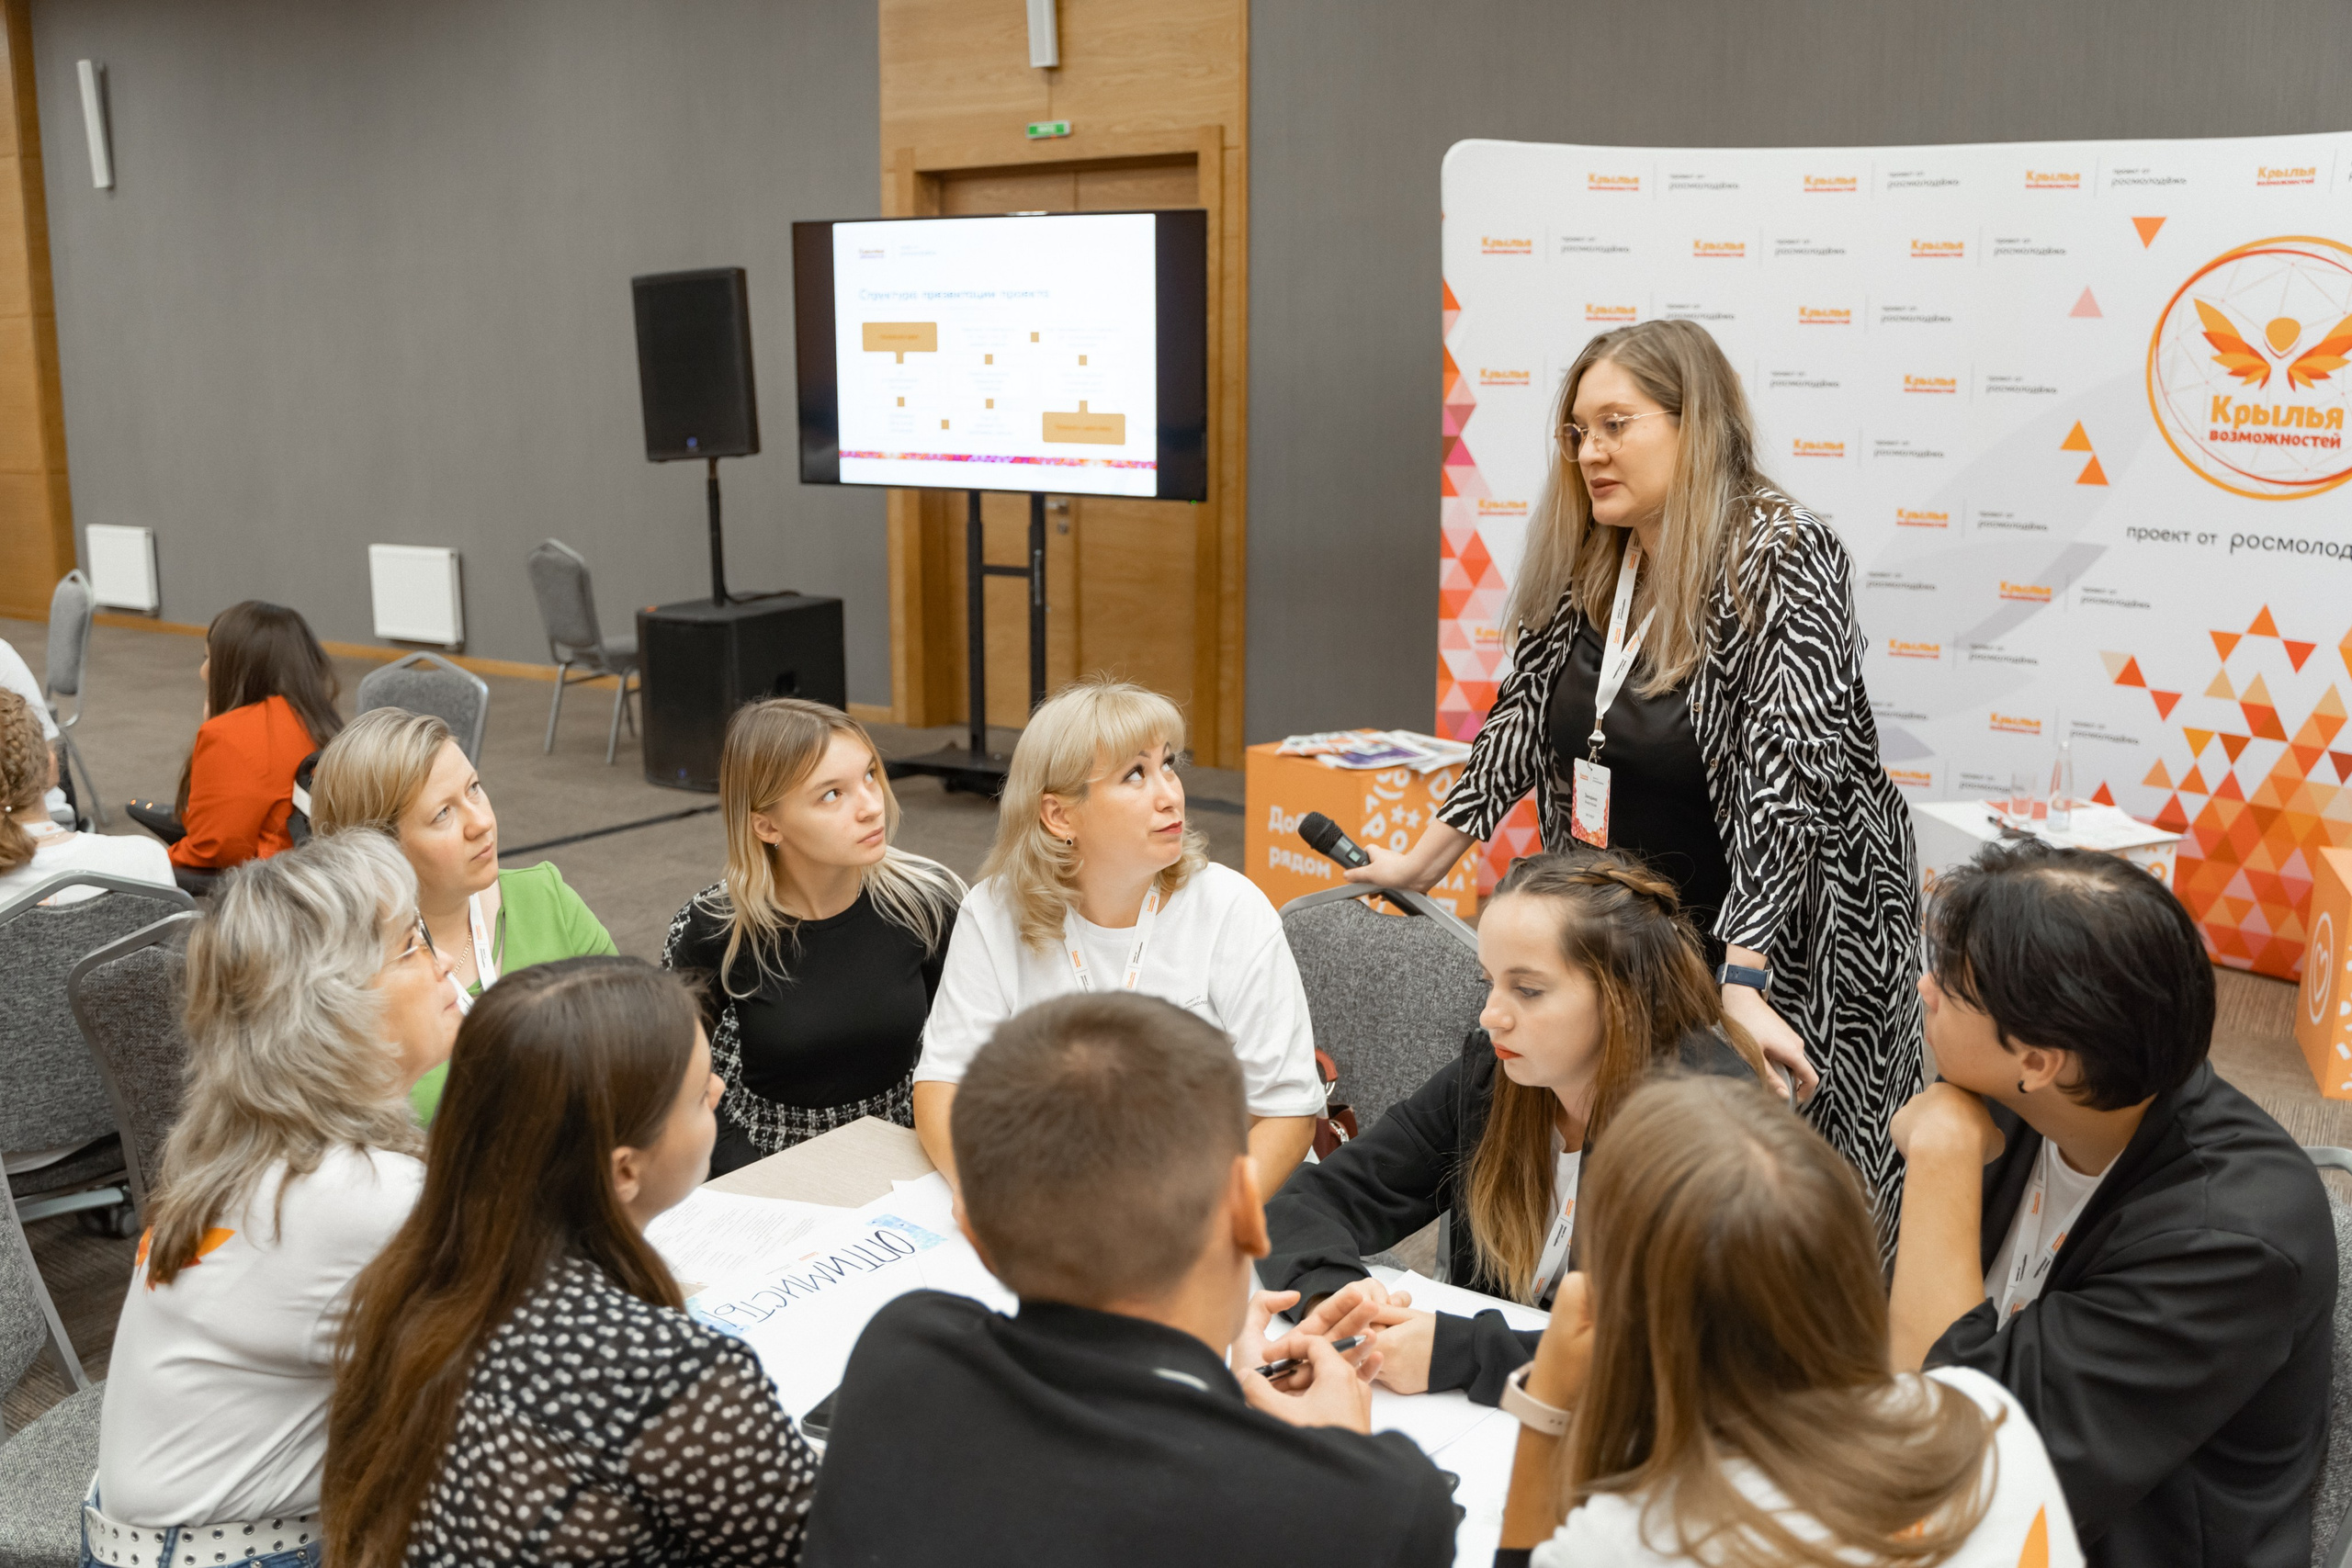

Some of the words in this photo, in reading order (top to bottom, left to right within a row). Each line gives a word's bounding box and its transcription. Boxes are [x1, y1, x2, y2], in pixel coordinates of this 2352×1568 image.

[2258, 167, 2316, 180] Крылья
[2211, 395, 2345, 430] Крылья
[2209, 429, 2342, 449] возможностей
[2126, 525, 2190, 543] проект
[2197, 531, 2218, 546] от
[2229, 533, 2352, 561] росмолод
[1269, 846, 1331, 880] рядом
[701, 1229, 916, 1328] ОПТИМИСТЫ
